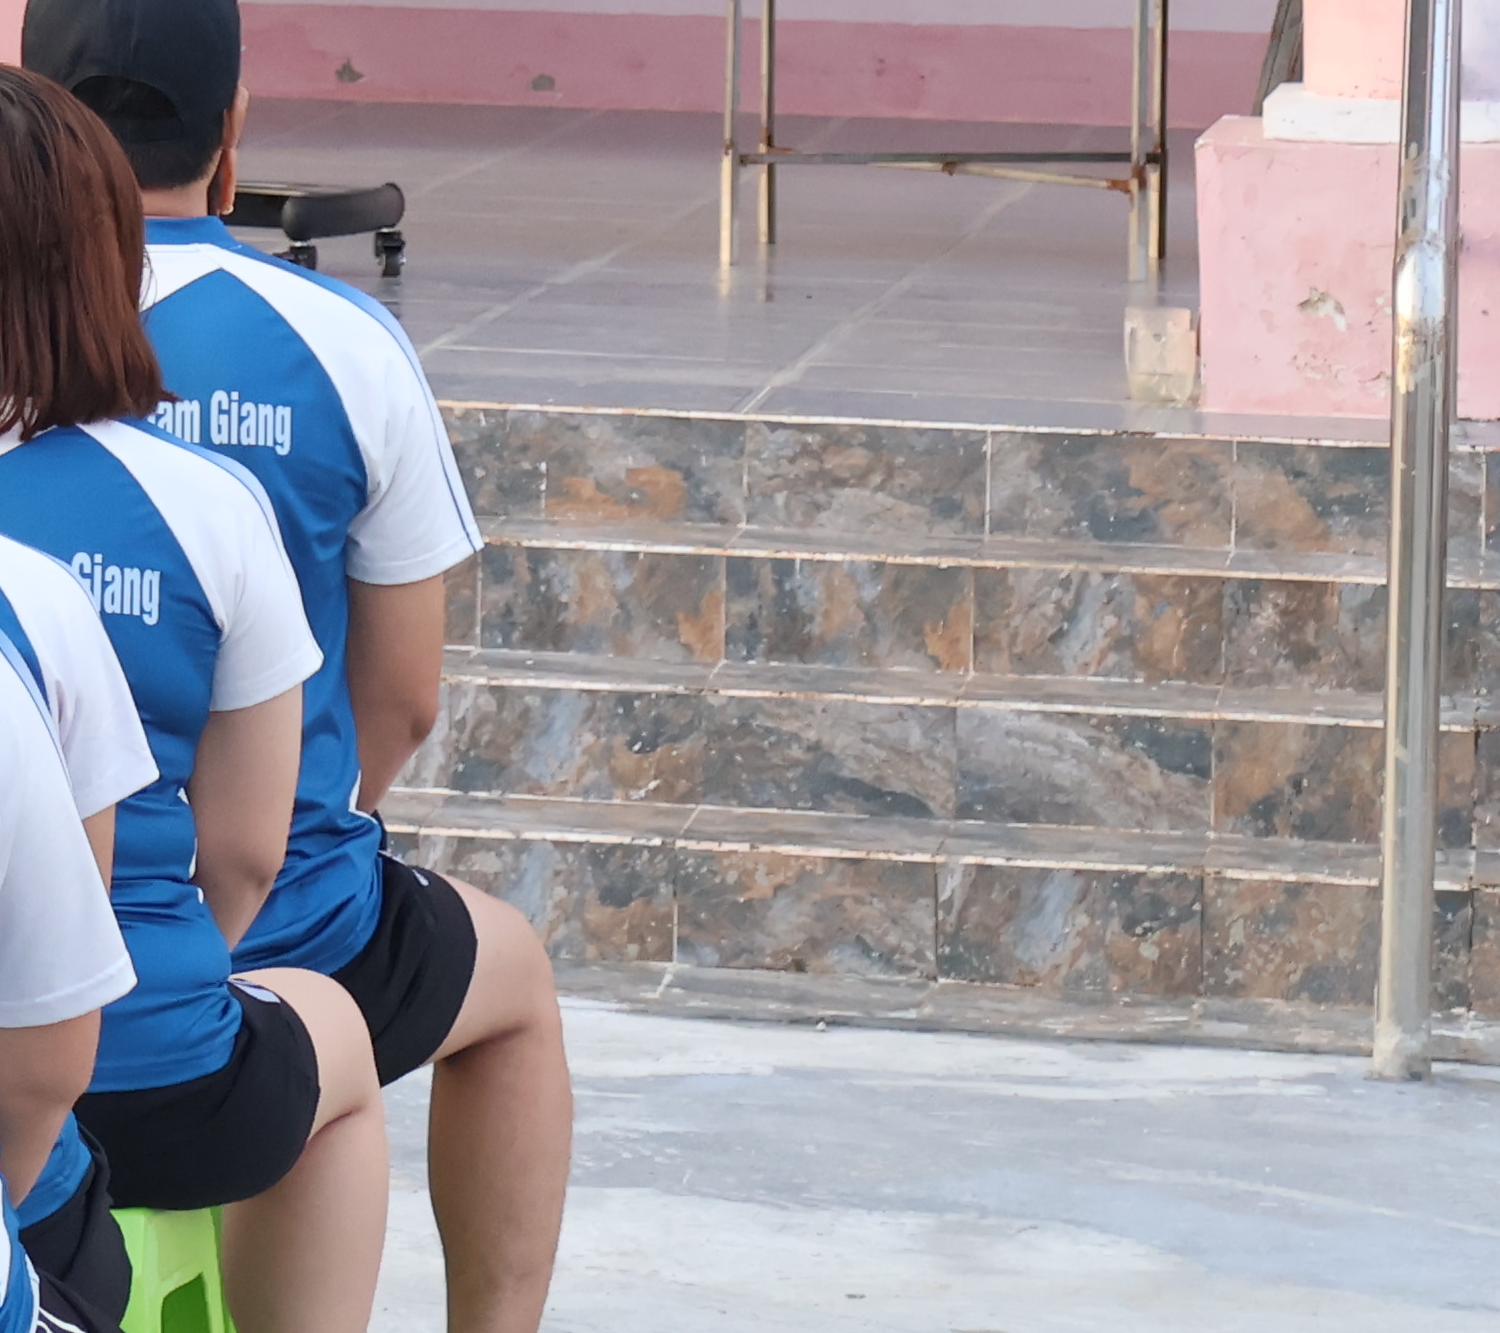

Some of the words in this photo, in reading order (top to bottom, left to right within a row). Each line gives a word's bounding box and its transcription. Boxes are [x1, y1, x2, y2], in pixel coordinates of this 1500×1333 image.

[147, 399, 200, 443] am
[210, 389, 292, 456] Giang
[71, 551, 161, 626] Giang
